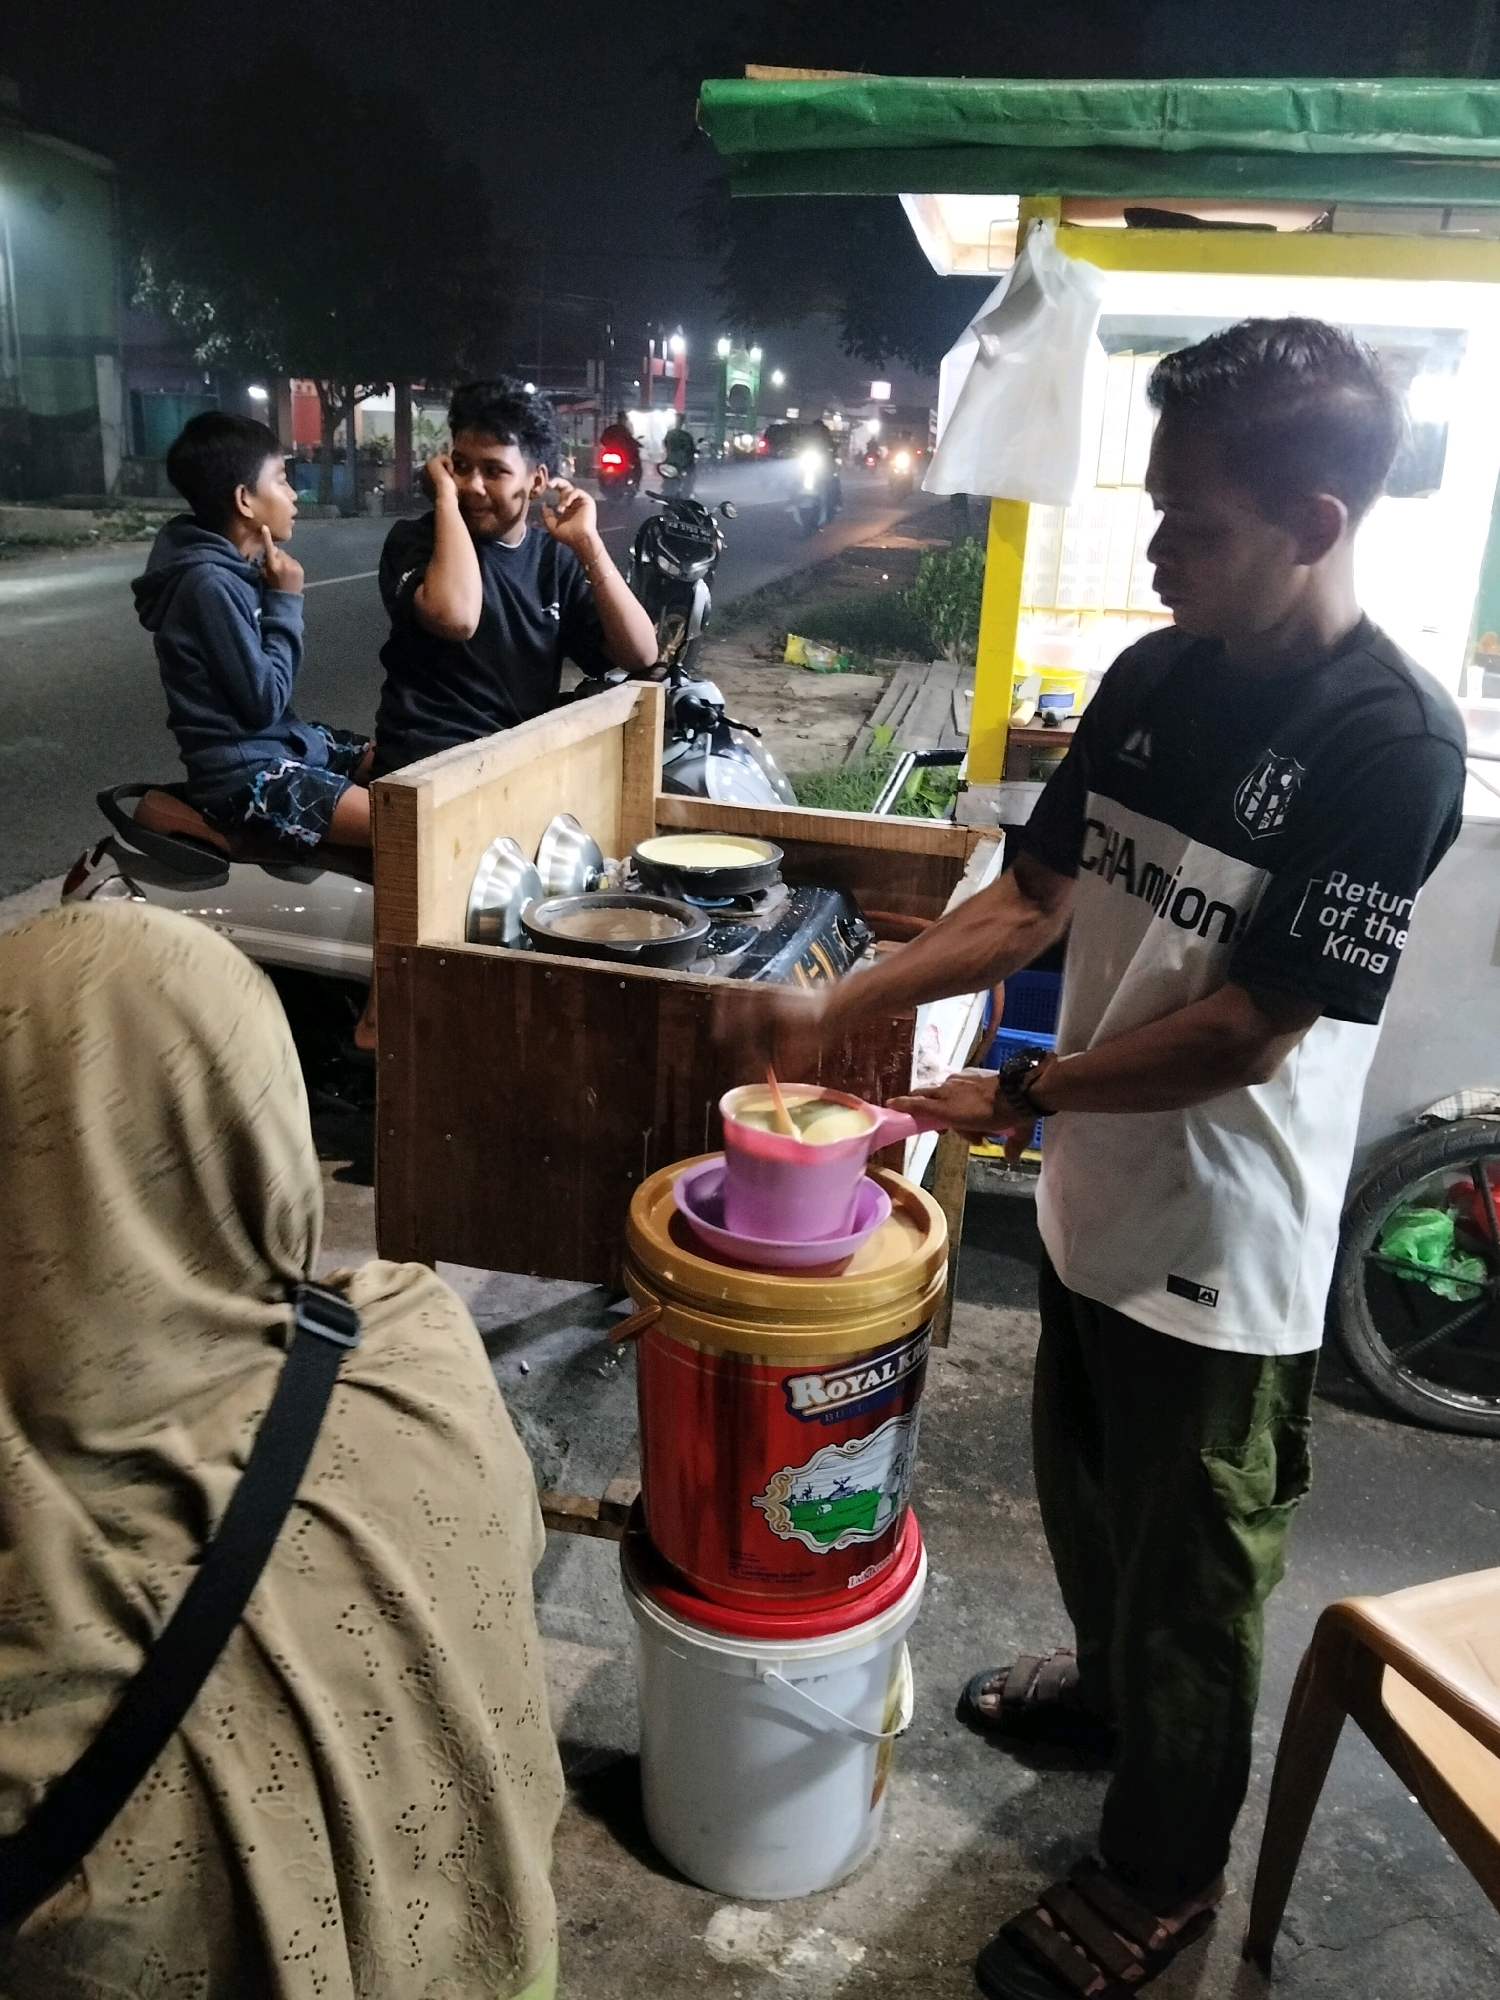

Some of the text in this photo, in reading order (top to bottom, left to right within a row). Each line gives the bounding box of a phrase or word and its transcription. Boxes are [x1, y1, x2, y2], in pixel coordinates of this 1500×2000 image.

[1324, 870, 1415, 919] Retur
[1319, 906, 1408, 949] of the
[1322, 931, 1389, 974] King
[788, 1363, 896, 1409] ROYAL
